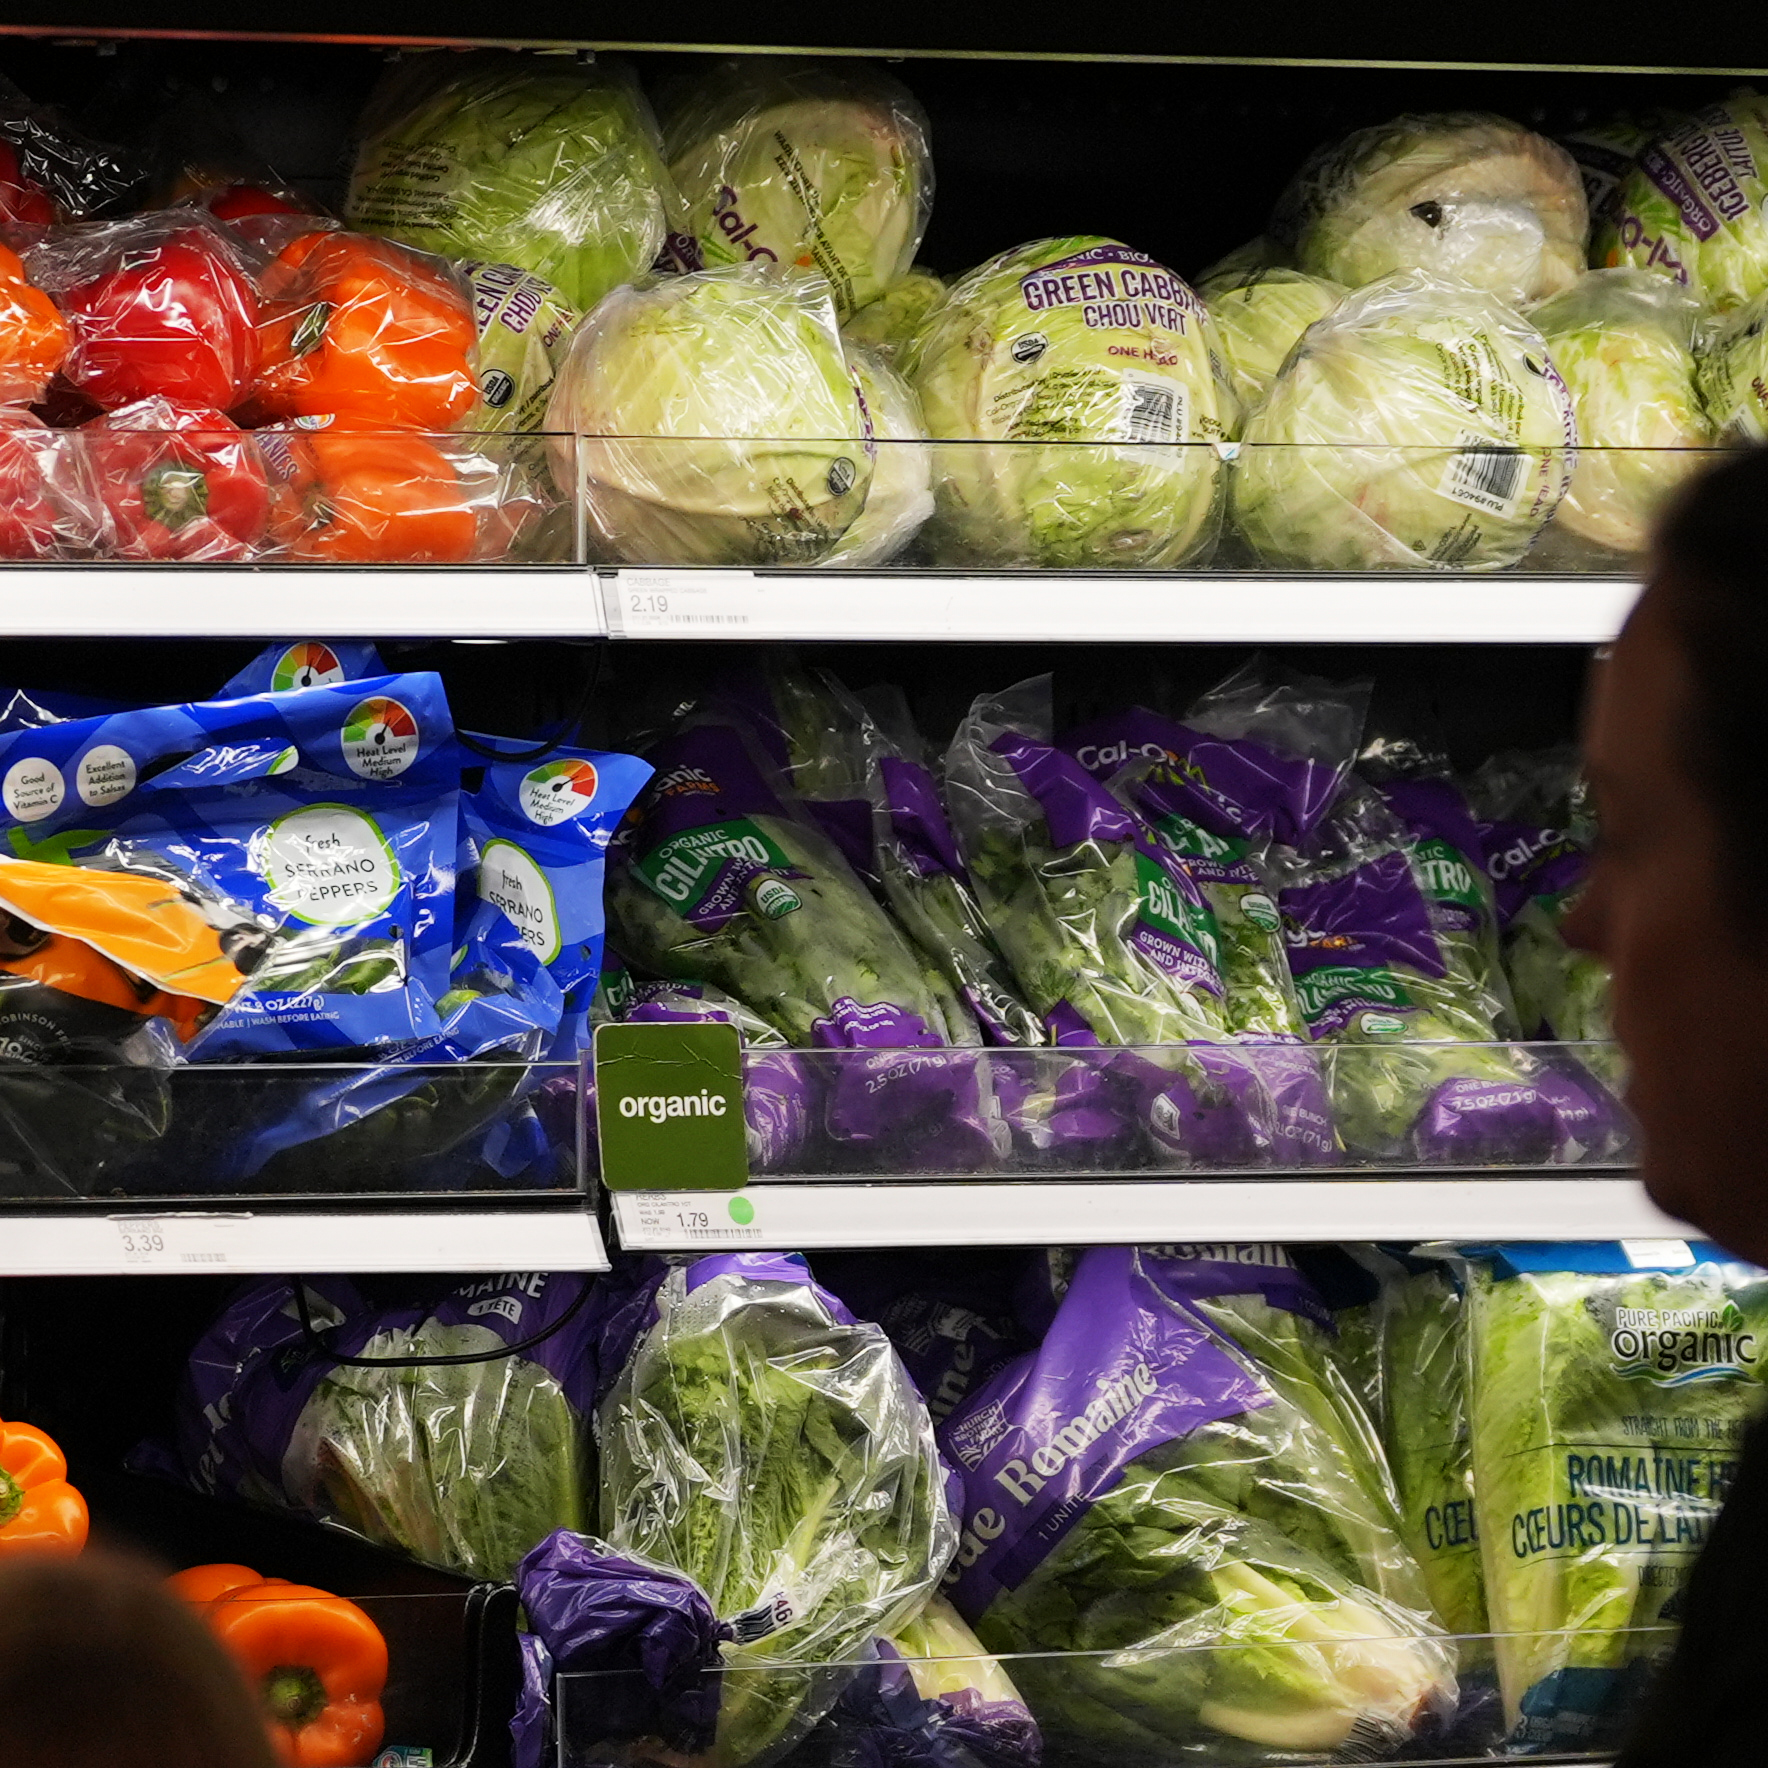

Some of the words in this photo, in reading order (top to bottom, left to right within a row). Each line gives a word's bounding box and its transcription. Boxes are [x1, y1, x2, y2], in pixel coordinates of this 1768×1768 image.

[1022, 270, 1117, 312] GREEN
[1083, 303, 1142, 331] CHOU
[1144, 302, 1187, 336] VERT
[1108, 345, 1140, 358] ONE
[631, 595, 669, 613] 2.19
[356, 746, 381, 758] Heat
[381, 743, 407, 755] Level
[85, 760, 126, 774] Excellent
[361, 756, 402, 768] Medium
[20, 772, 45, 785] Good
[88, 772, 126, 786] Addition
[369, 766, 394, 779] High
[13, 788, 44, 799] Source
[46, 782, 56, 793] of
[529, 787, 553, 800] Heat
[552, 793, 576, 806] Level
[12, 798, 48, 811] Vitamin
[49, 794, 59, 804] C
[530, 799, 564, 814] Medium
[534, 810, 554, 825] High
[305, 833, 341, 852] fresh
[659, 828, 729, 859] ORGANIC
[284, 858, 375, 878] SERRANO
[656, 835, 771, 900] CILNTRO
[501, 869, 523, 892] fresh
[698, 876, 732, 915] GROWN
[489, 890, 544, 924] SERRANO
[1140, 931, 1181, 957] GROWN
[1149, 948, 1175, 968] AND
[266, 998, 286, 1012] OZ
[251, 1016, 276, 1026] WASH
[277, 1012, 310, 1025] BEFORE
[310, 1010, 340, 1022] EATING
[865, 1073, 887, 1094] 2.5
[886, 1063, 907, 1081] OZ
[619, 1088, 727, 1124] organic
[640, 1217, 660, 1226] NOW
[676, 1211, 709, 1228] 1.79
[122, 1234, 164, 1252] 3.39
[1615, 1307, 1659, 1329] PURE
[1662, 1310, 1720, 1330] PACIFIC
[994, 1362, 1158, 1508] Romaine
[1567, 1453, 1704, 1499] ROMAINE
[1613, 1502, 1653, 1546] DE
